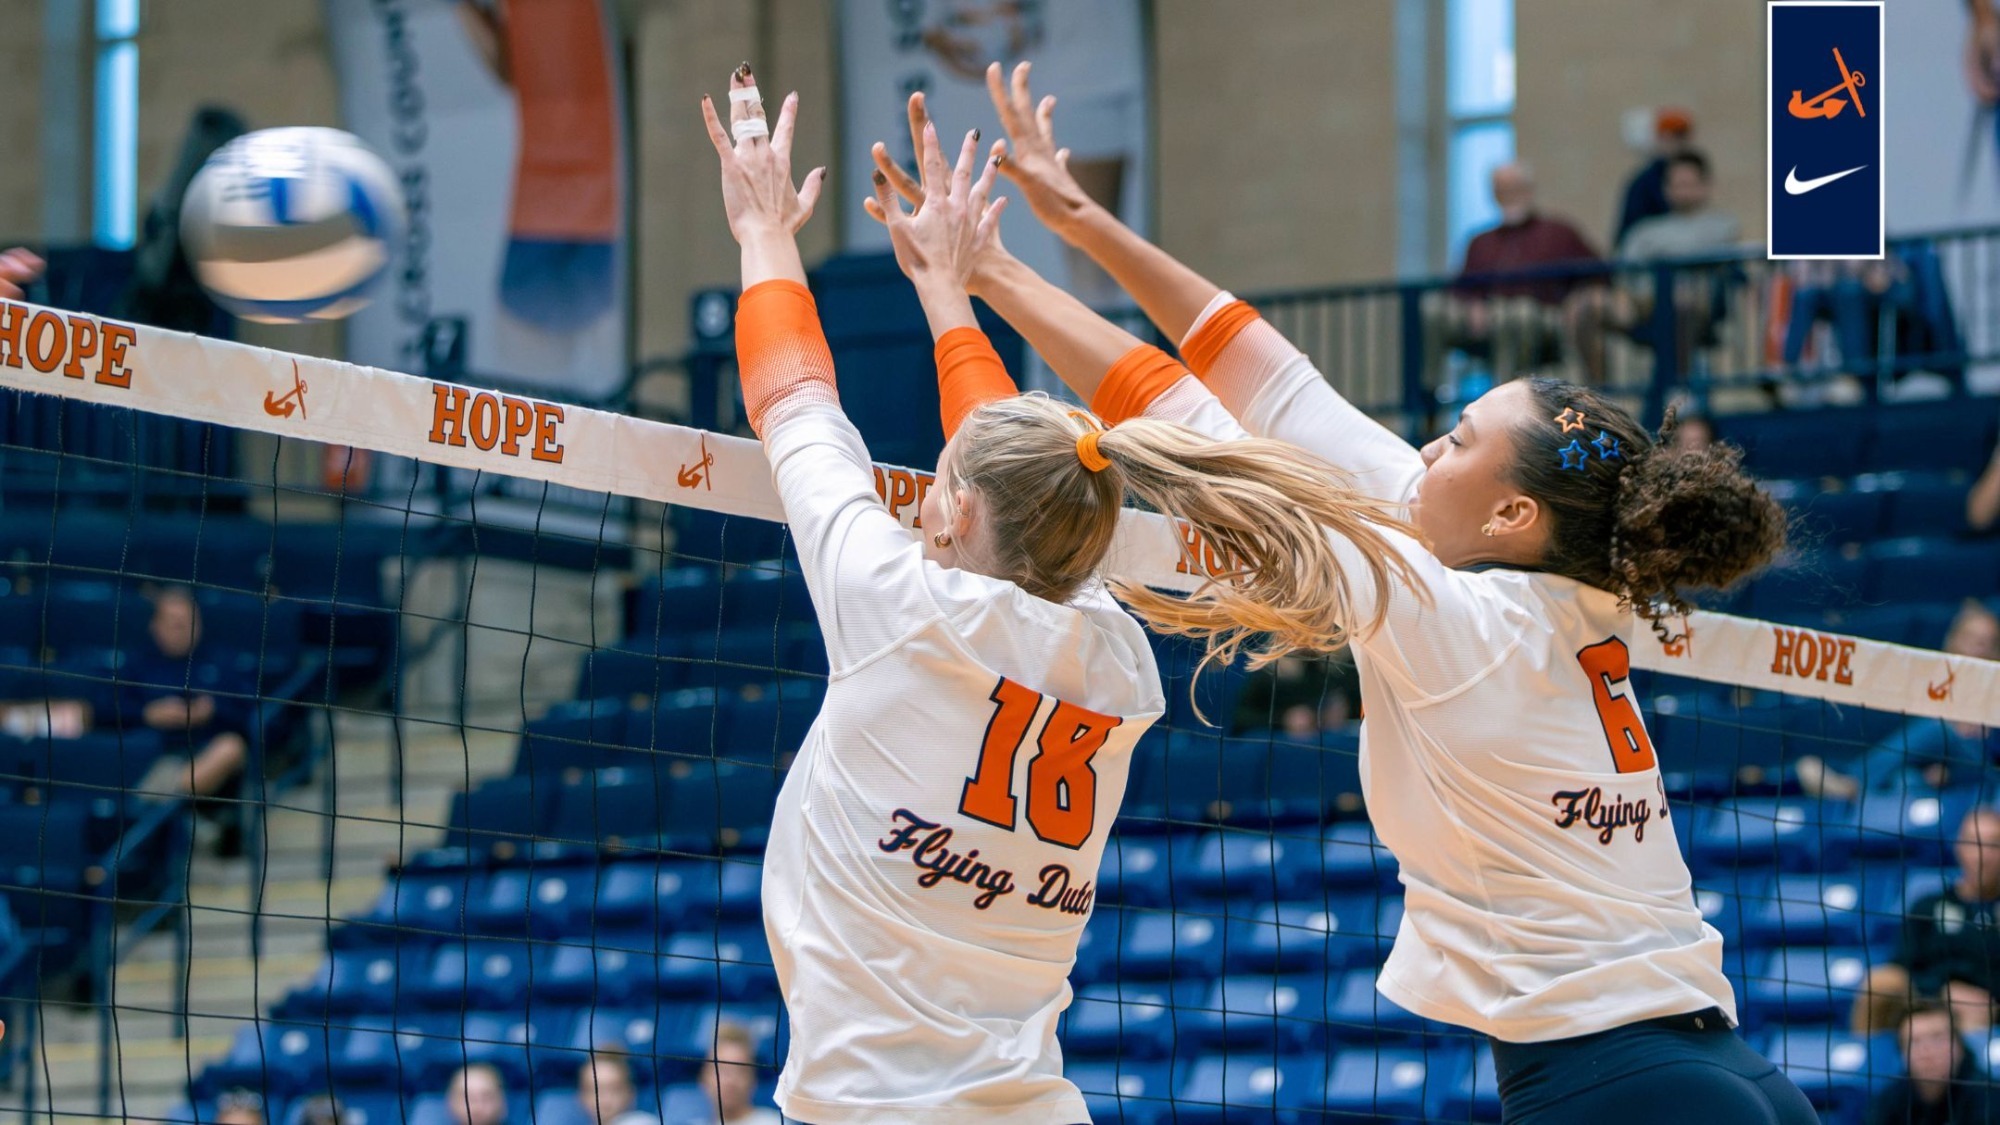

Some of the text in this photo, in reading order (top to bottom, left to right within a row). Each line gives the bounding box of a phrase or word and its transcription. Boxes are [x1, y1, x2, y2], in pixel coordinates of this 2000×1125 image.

[0, 302, 136, 389] HOPE
[429, 383, 565, 464] HOPE
[1770, 626, 1856, 686] HOPE
[1576, 634, 1656, 774] 6
[958, 675, 1123, 851] 18
[878, 808, 1015, 910] Flying
[1552, 786, 1651, 845] Flying
